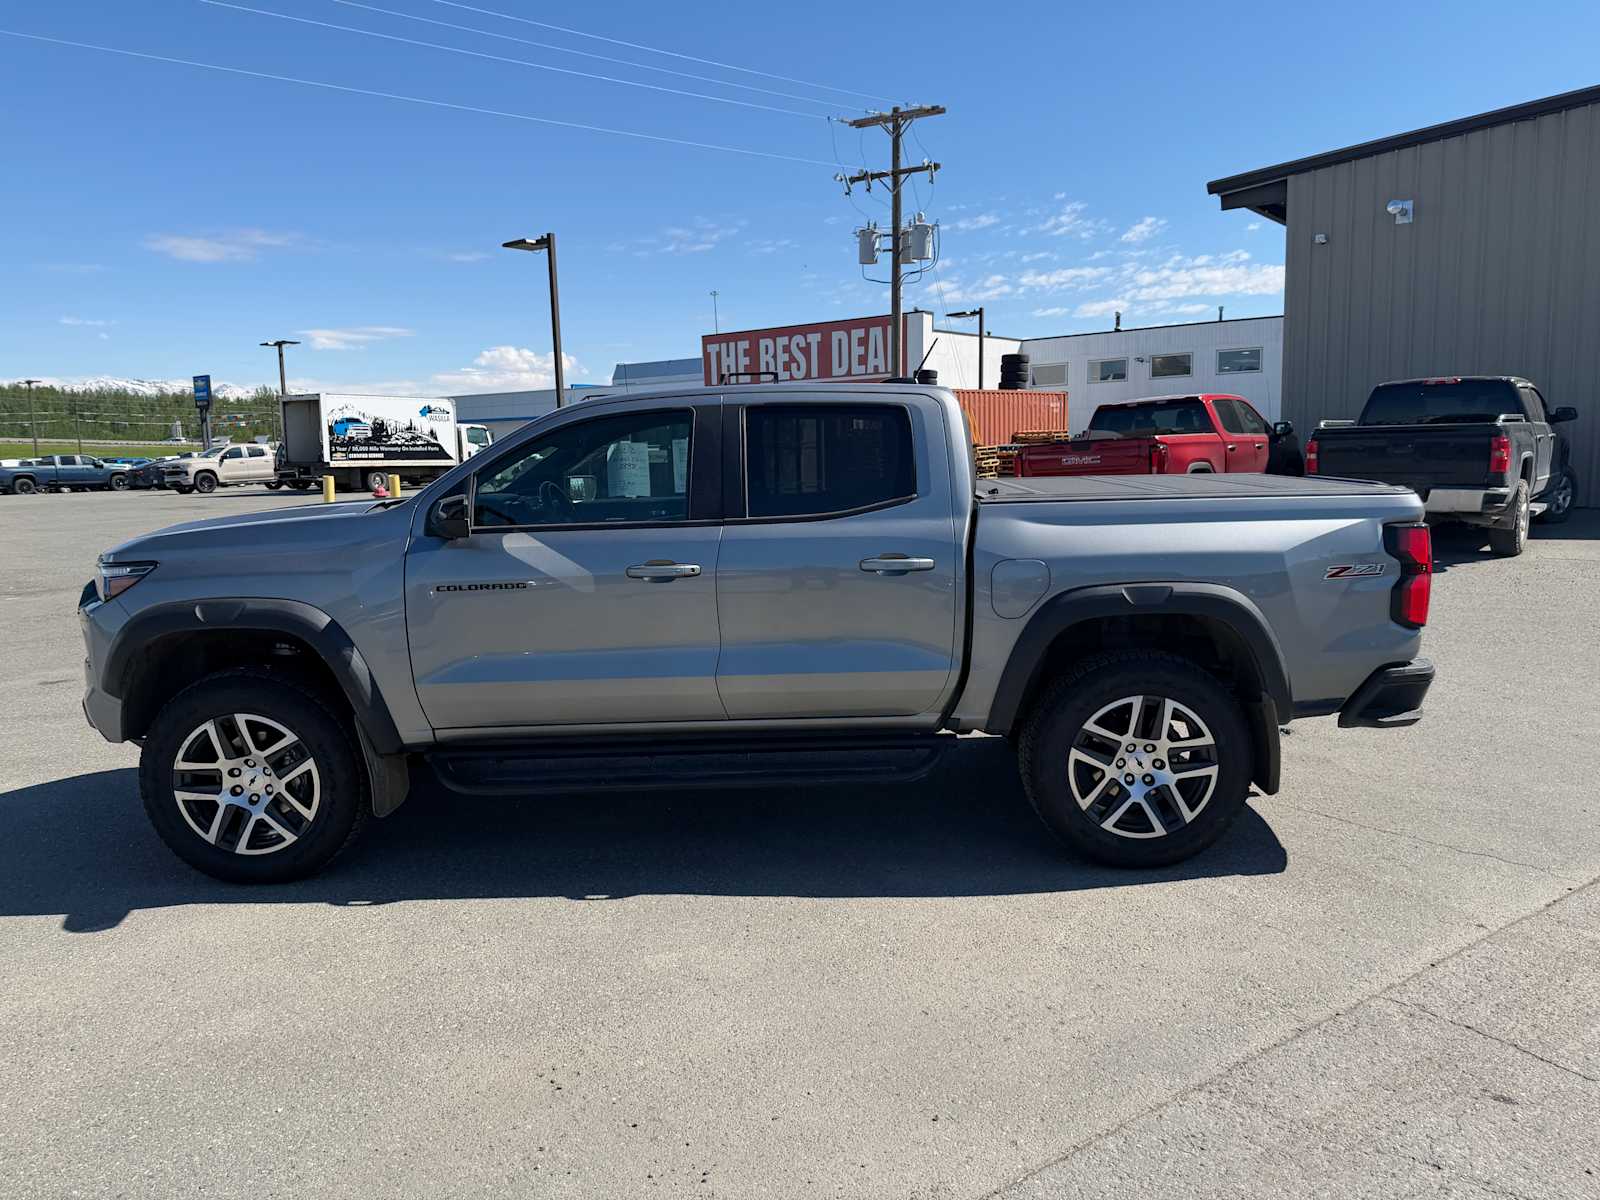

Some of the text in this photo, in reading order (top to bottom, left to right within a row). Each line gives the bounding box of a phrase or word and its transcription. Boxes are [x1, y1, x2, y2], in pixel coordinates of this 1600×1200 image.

[706, 338, 751, 386] THE
[759, 332, 821, 384] BEST
[1061, 455, 1101, 465] GMC
[1324, 564, 1385, 579] Z71
[435, 582, 528, 593] COLORADO
